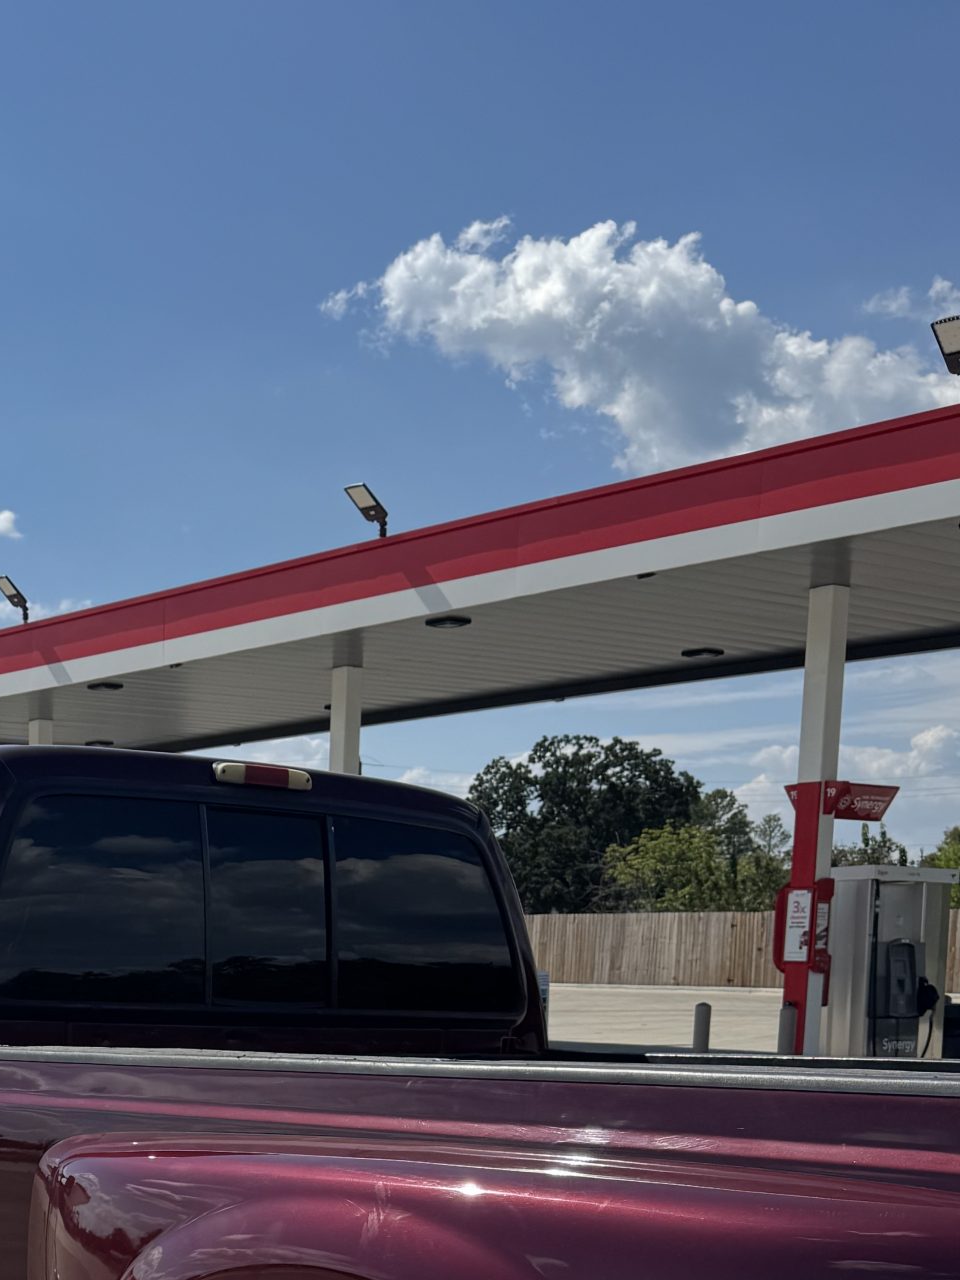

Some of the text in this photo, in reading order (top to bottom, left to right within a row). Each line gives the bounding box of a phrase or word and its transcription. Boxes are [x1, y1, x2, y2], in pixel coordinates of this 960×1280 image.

[826, 787, 837, 798] 19
[851, 797, 887, 813] Synergy
[882, 1037, 916, 1053] Synergy
